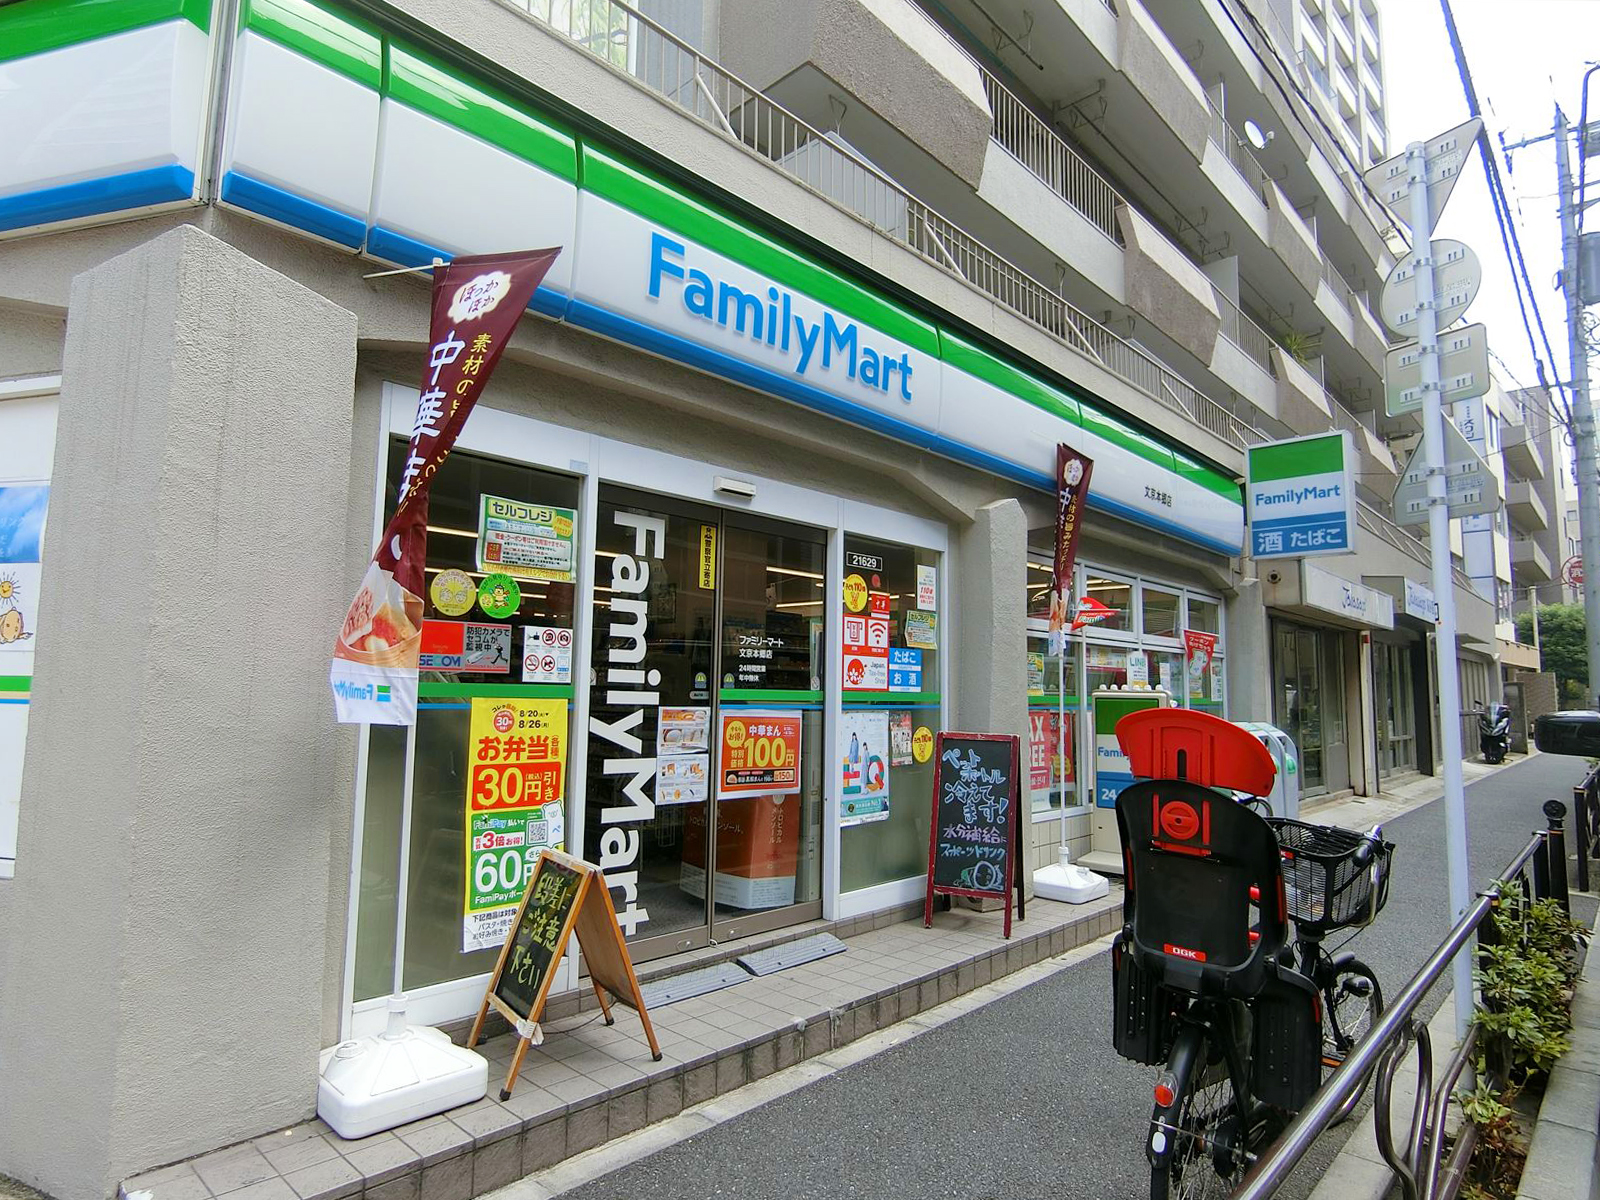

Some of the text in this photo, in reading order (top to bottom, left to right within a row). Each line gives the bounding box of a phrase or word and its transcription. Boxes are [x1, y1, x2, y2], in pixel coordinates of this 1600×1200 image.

[459, 279, 499, 303] ほっか
[468, 296, 495, 313] ほか
[648, 231, 914, 402] FamilyMart
[1255, 485, 1341, 507] FamilyMart
[1258, 528, 1342, 553] 酒 たばこ
[852, 555, 877, 568] 21629
[466, 627, 510, 636] 防犯カメラで
[465, 642, 492, 652] 監視中
[739, 635, 784, 648] ファミリーマート
[419, 655, 461, 667] SECOM
[893, 650, 916, 664] たばこ
[590, 510, 666, 936] FamilyMart
[749, 725, 781, 736] 中華まん
[477, 735, 549, 761] お弁当
[944, 780, 995, 803] 冷えて
[940, 843, 1006, 861] スポーツドリンク
[475, 891, 524, 904] FamiPayボー
[1172, 947, 1197, 959] OGK
